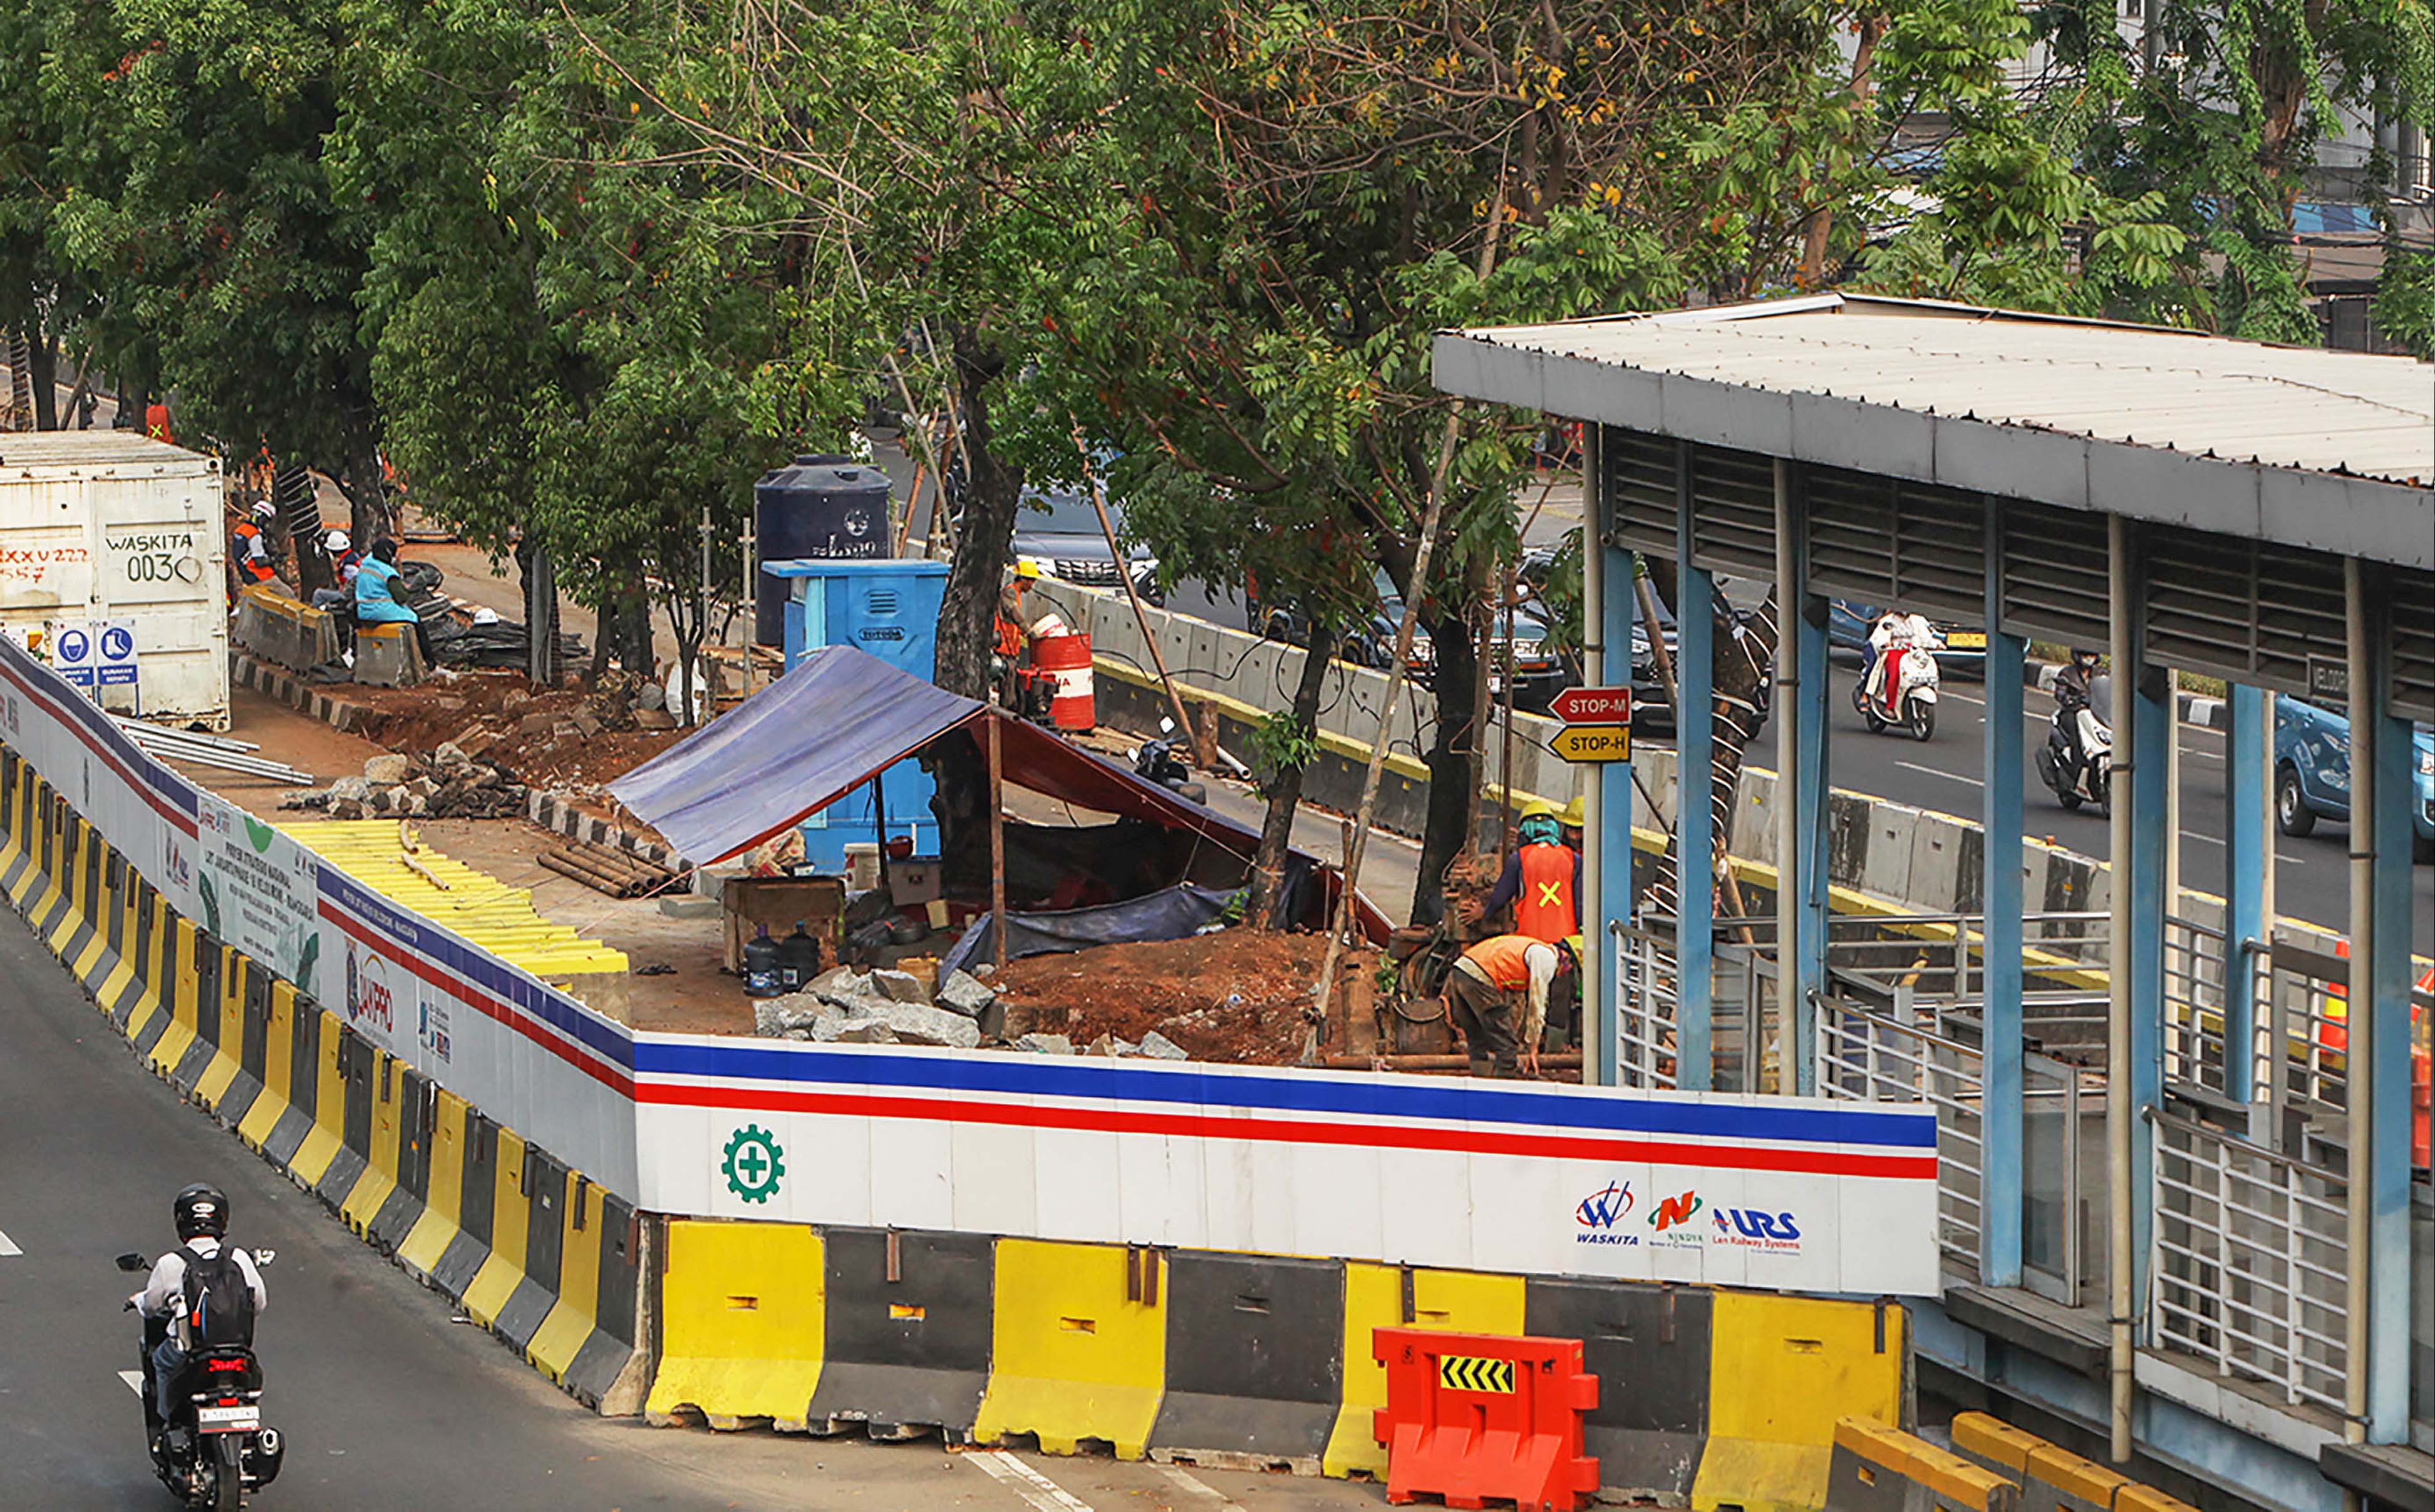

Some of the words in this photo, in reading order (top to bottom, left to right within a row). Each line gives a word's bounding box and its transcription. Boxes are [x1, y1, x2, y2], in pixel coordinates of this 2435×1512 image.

[106, 533, 193, 551] WASKITA
[1569, 698, 1626, 714] STOP-M
[1569, 736, 1625, 751] STOP-H
[1576, 1233, 1639, 1246] WASKITA
[1712, 1235, 1728, 1245] Len
[1730, 1236, 1762, 1248] Railway
[1765, 1238, 1800, 1250] Systems
